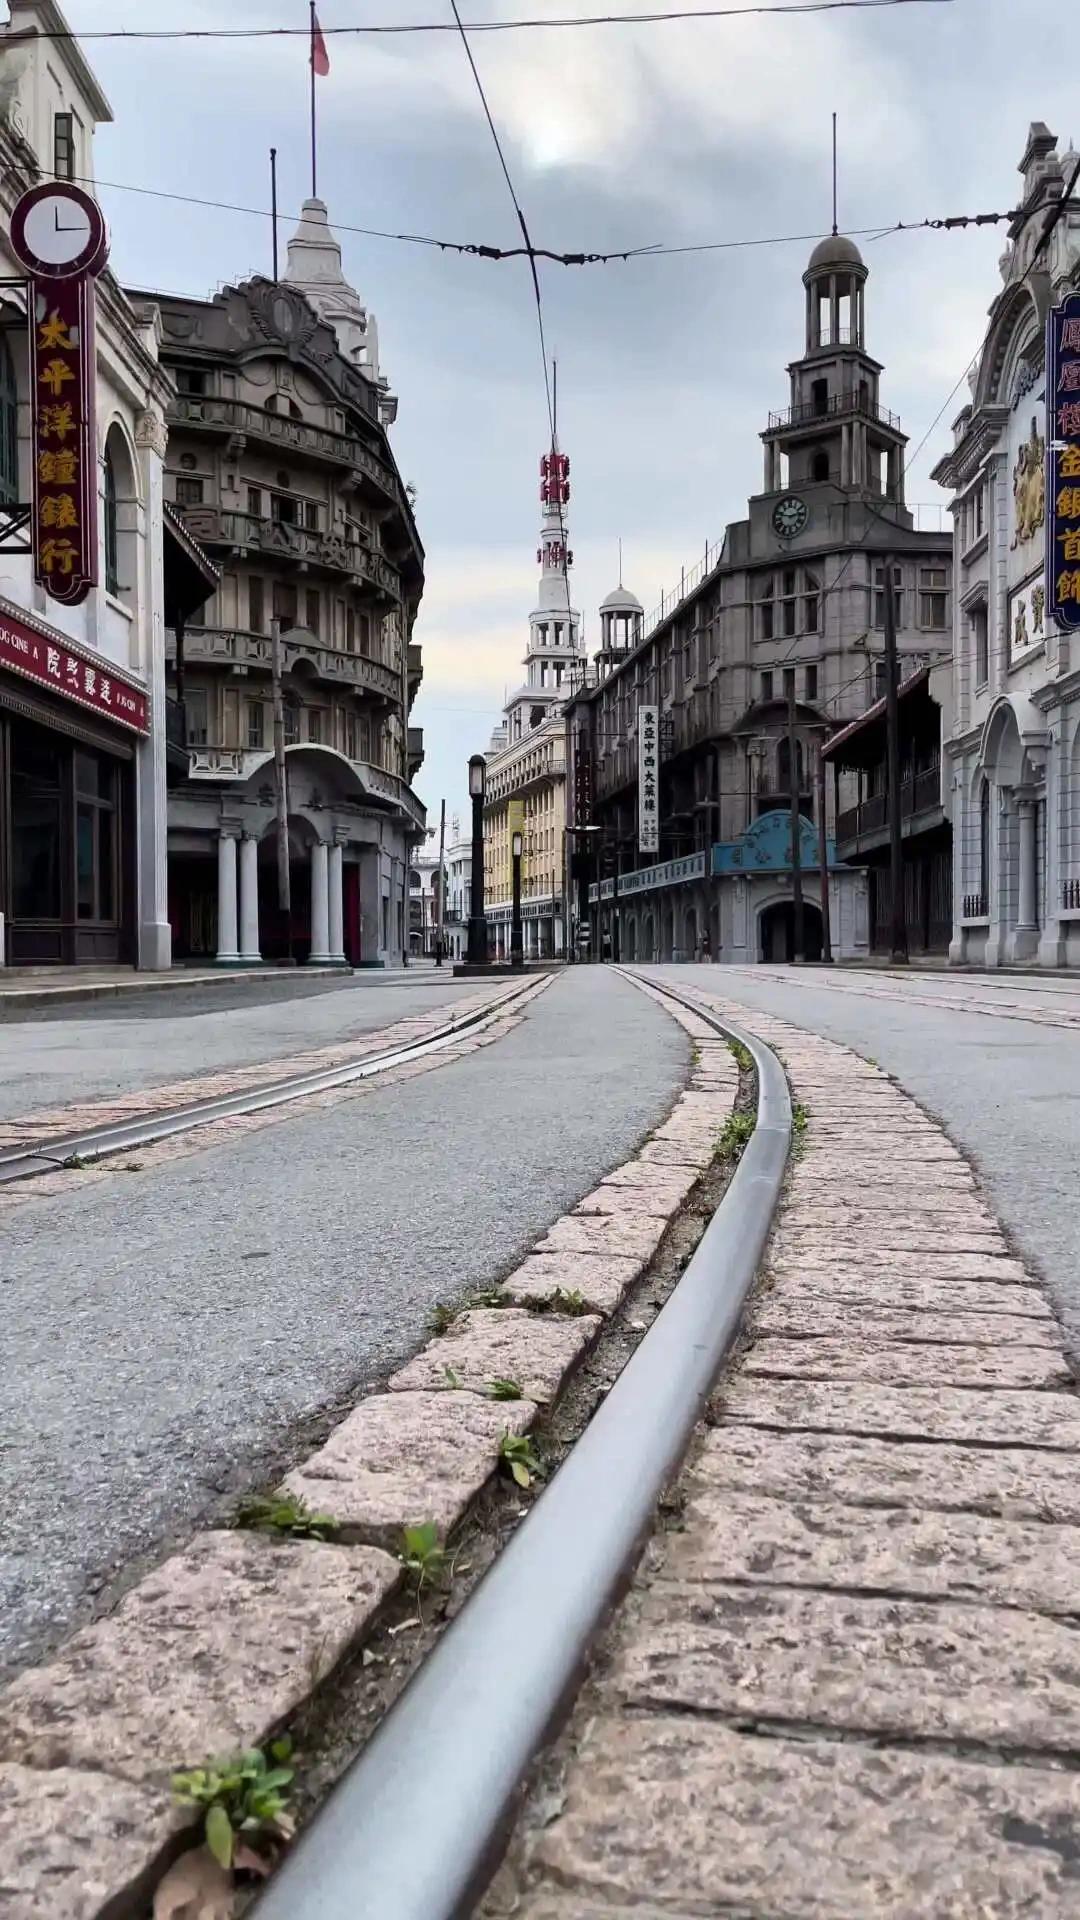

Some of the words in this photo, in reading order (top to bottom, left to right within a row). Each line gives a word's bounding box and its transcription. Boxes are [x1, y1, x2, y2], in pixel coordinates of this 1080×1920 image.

[38, 308, 80, 575] 太平洋鐘錶行
